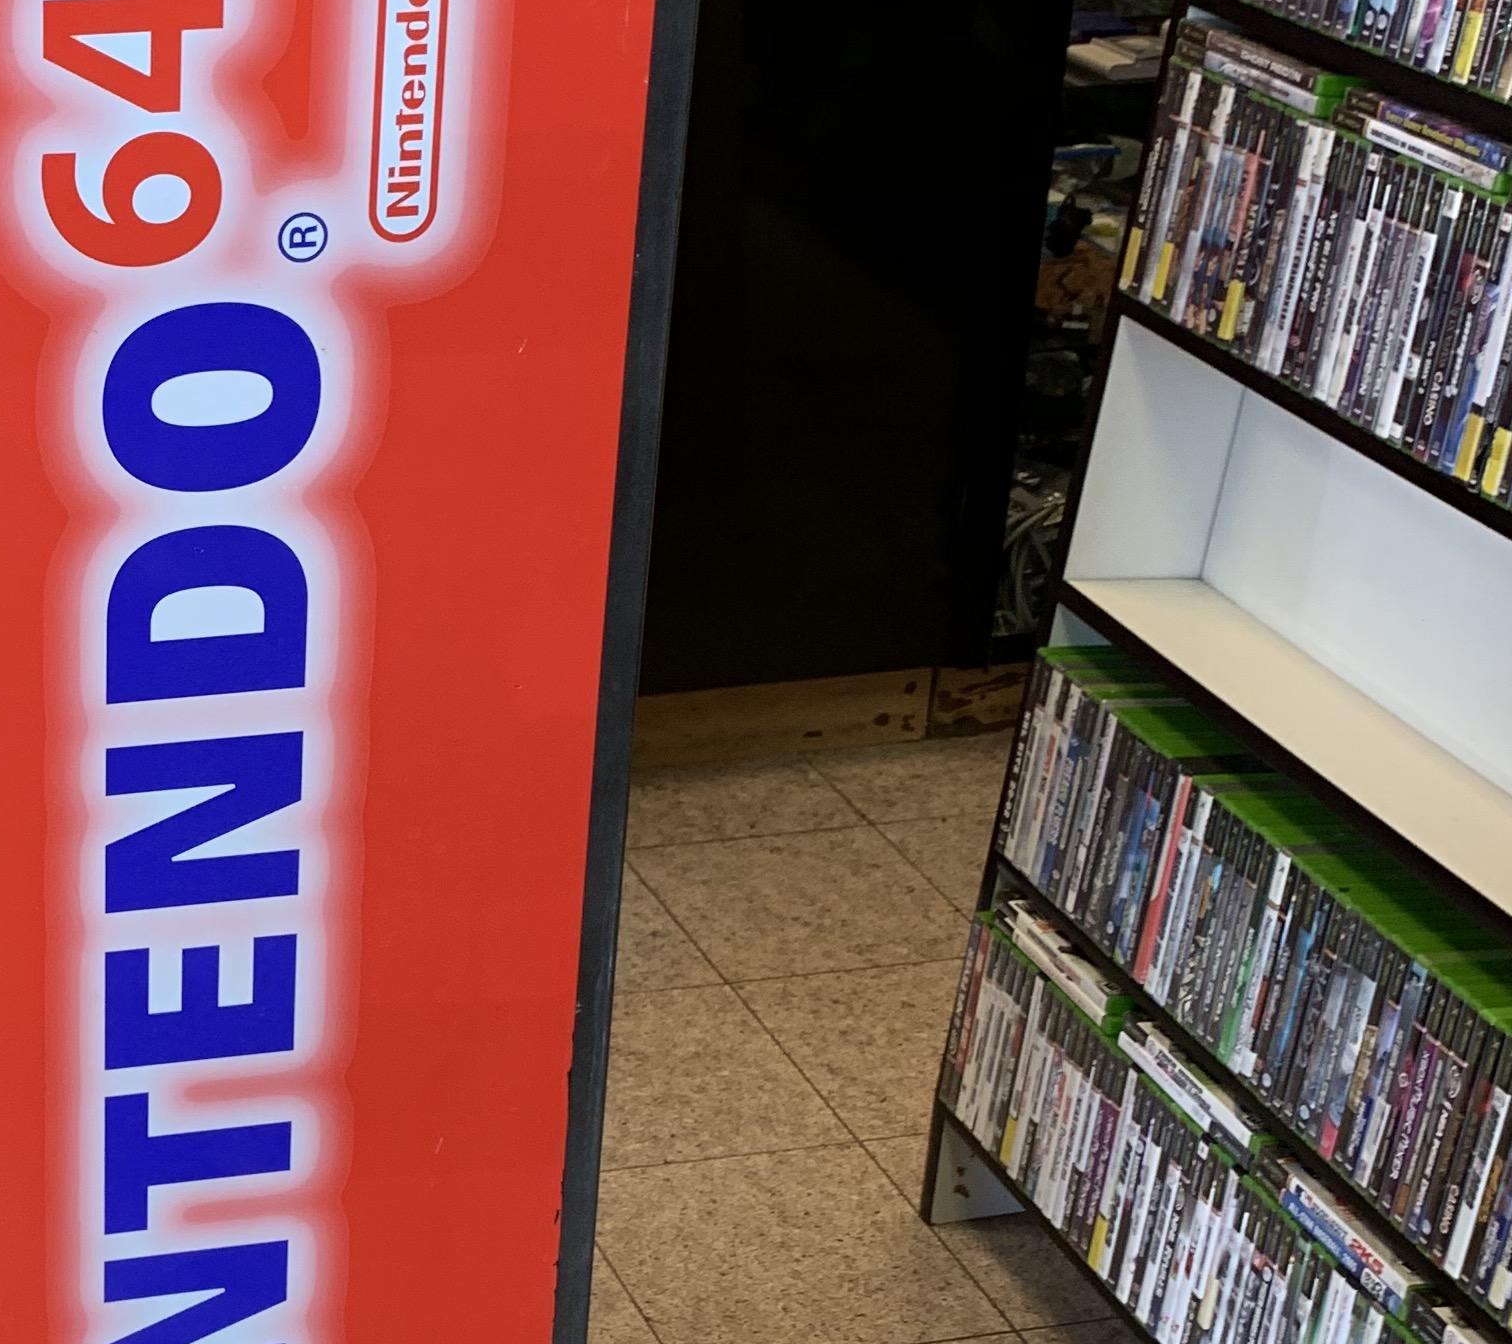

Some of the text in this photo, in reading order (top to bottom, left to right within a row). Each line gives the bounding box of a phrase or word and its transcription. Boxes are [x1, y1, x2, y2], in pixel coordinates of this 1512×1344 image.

[1421, 369, 1443, 426] CASINO
[1437, 1183, 1460, 1235] CASINO
[1346, 1236, 1387, 1277] 2K5
